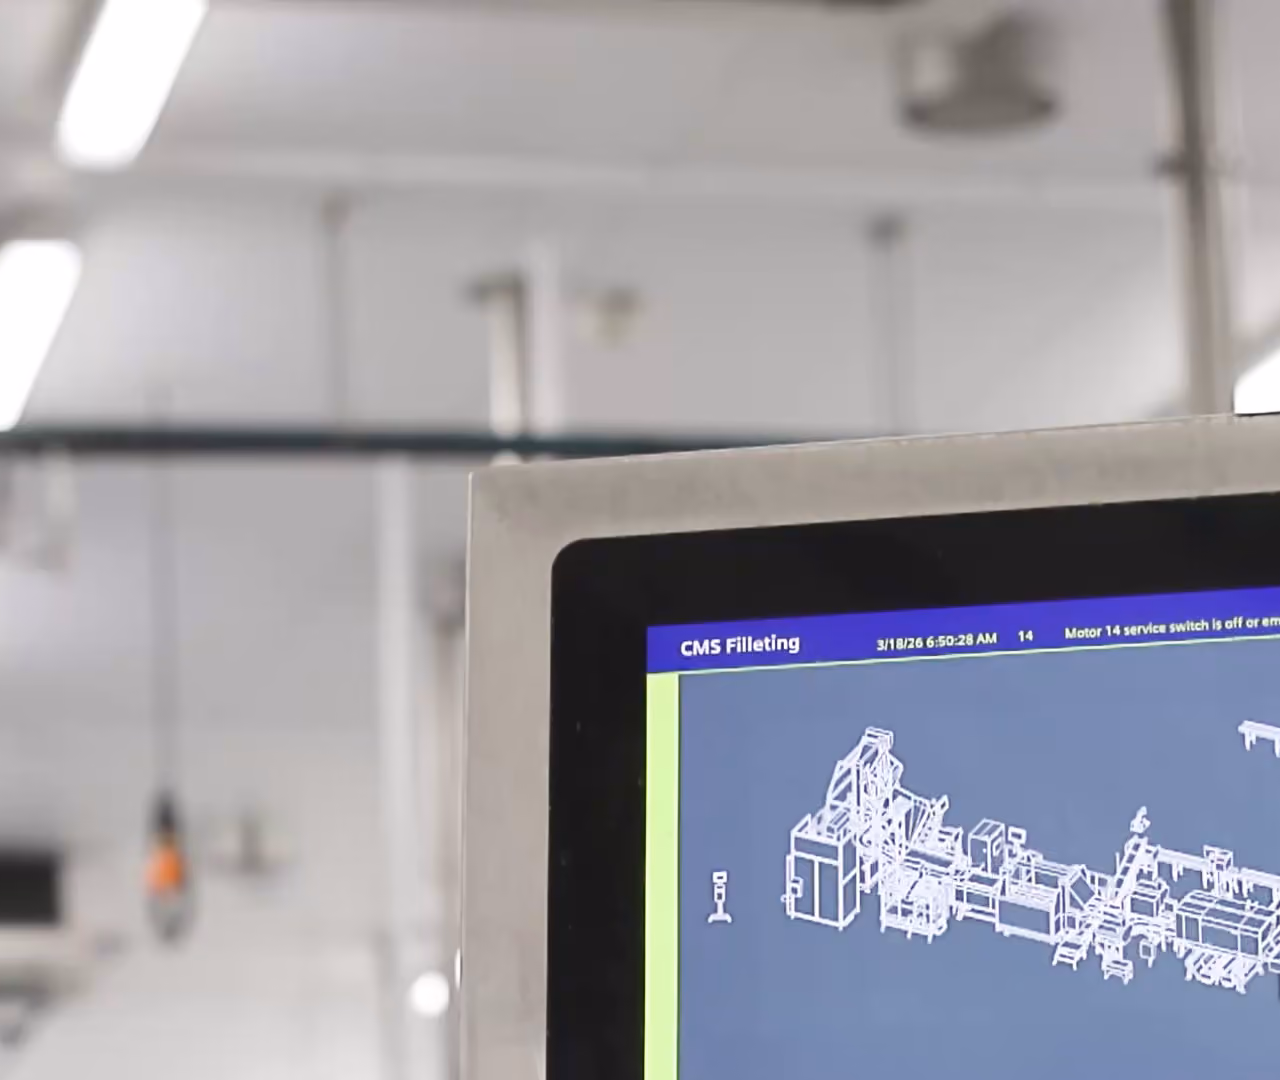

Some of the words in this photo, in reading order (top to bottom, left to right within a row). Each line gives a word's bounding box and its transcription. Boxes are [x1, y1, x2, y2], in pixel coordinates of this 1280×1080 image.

[1018, 630, 1034, 642] 14
[1064, 627, 1102, 639] Motor
[1105, 624, 1121, 637] 14
[1124, 622, 1167, 636] service
[1169, 617, 1210, 633] switch
[1212, 617, 1223, 630] is
[1225, 615, 1244, 629] off
[1246, 617, 1260, 628] or
[681, 638, 722, 656] CMS
[726, 634, 800, 654] Filleting
[876, 637, 923, 651] 3/18/26
[926, 633, 973, 648] 6:50:28
[976, 632, 998, 645] AM
